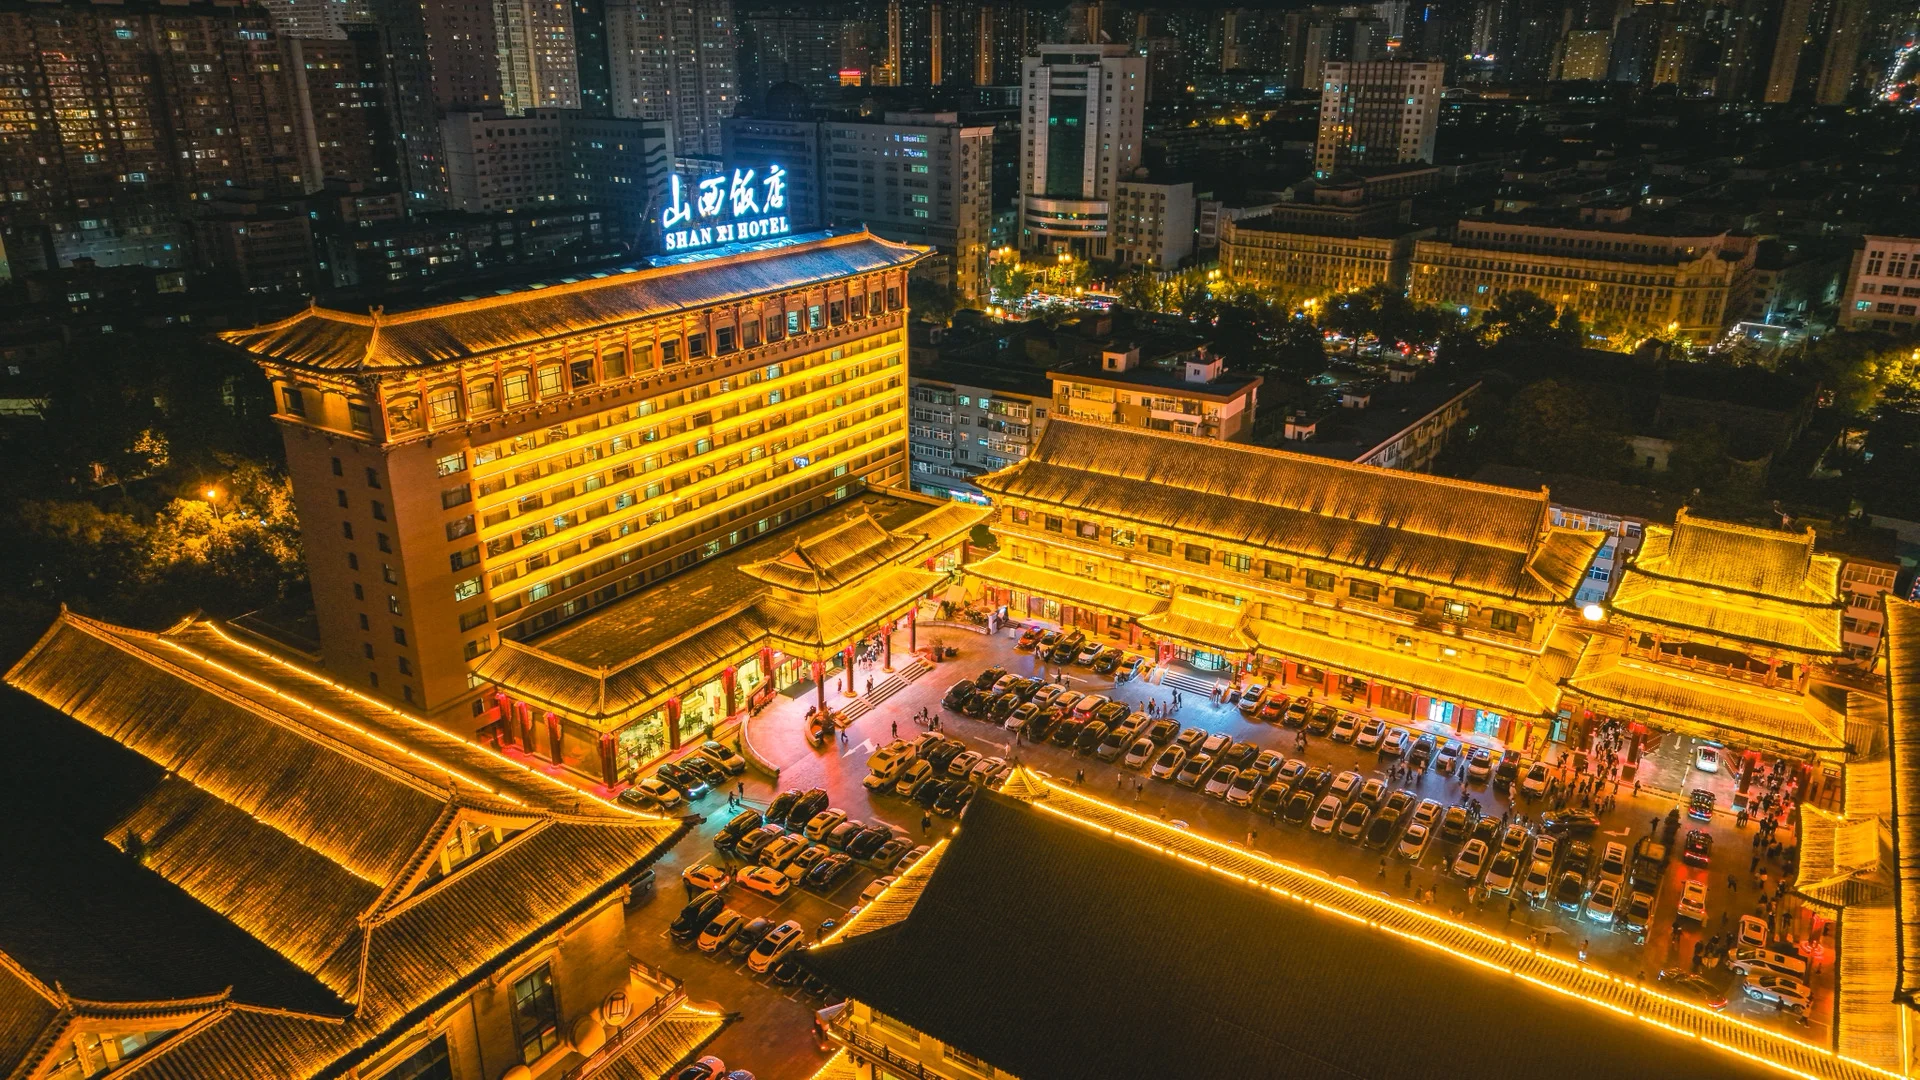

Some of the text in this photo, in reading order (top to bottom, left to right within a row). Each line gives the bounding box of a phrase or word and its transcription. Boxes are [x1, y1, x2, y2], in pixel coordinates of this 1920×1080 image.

[663, 164, 786, 229] 山西饭店
[666, 216, 789, 251] SHAN XI HOTEL
